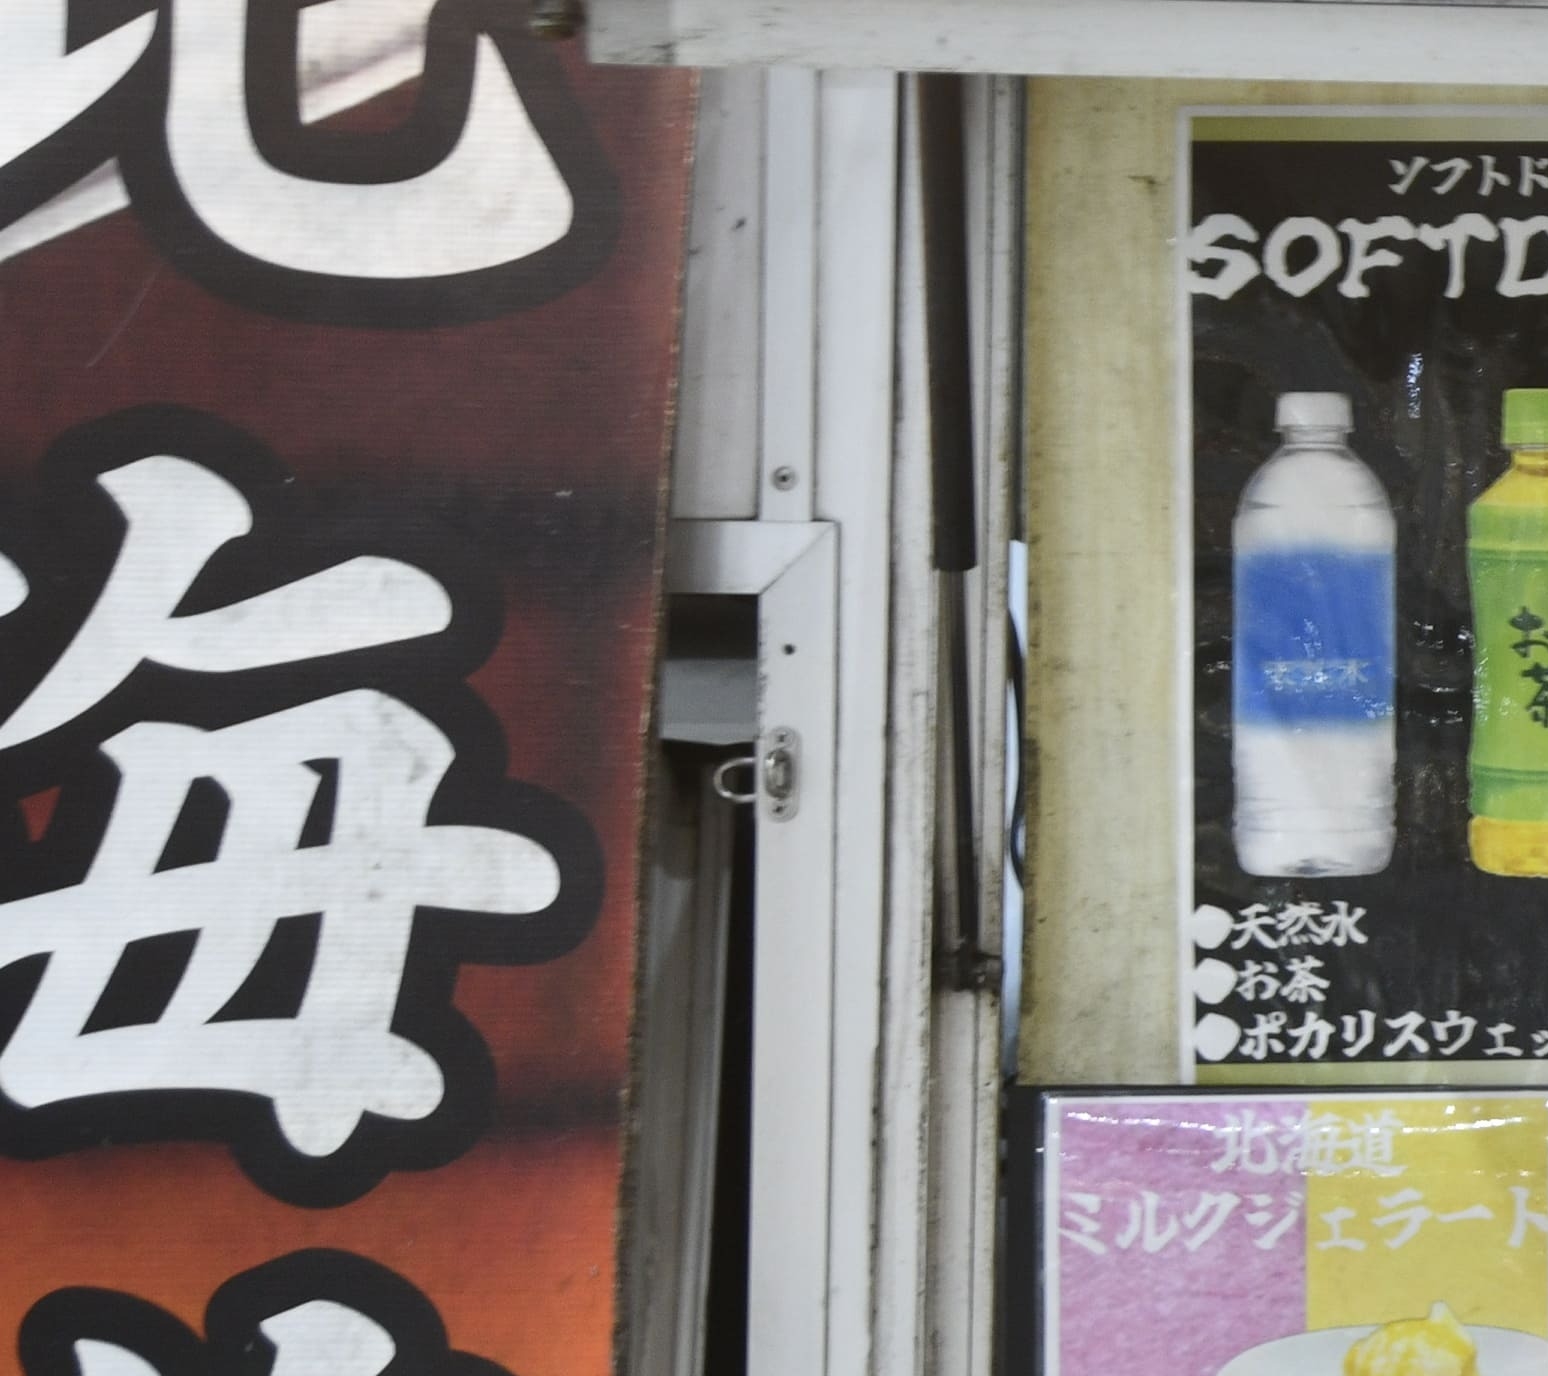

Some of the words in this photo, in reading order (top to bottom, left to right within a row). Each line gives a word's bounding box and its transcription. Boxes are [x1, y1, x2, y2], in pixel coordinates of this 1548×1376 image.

[1232, 899, 1369, 948] 天然水
[1235, 956, 1332, 1004] お茶
[1212, 1108, 1407, 1178] 北海道
